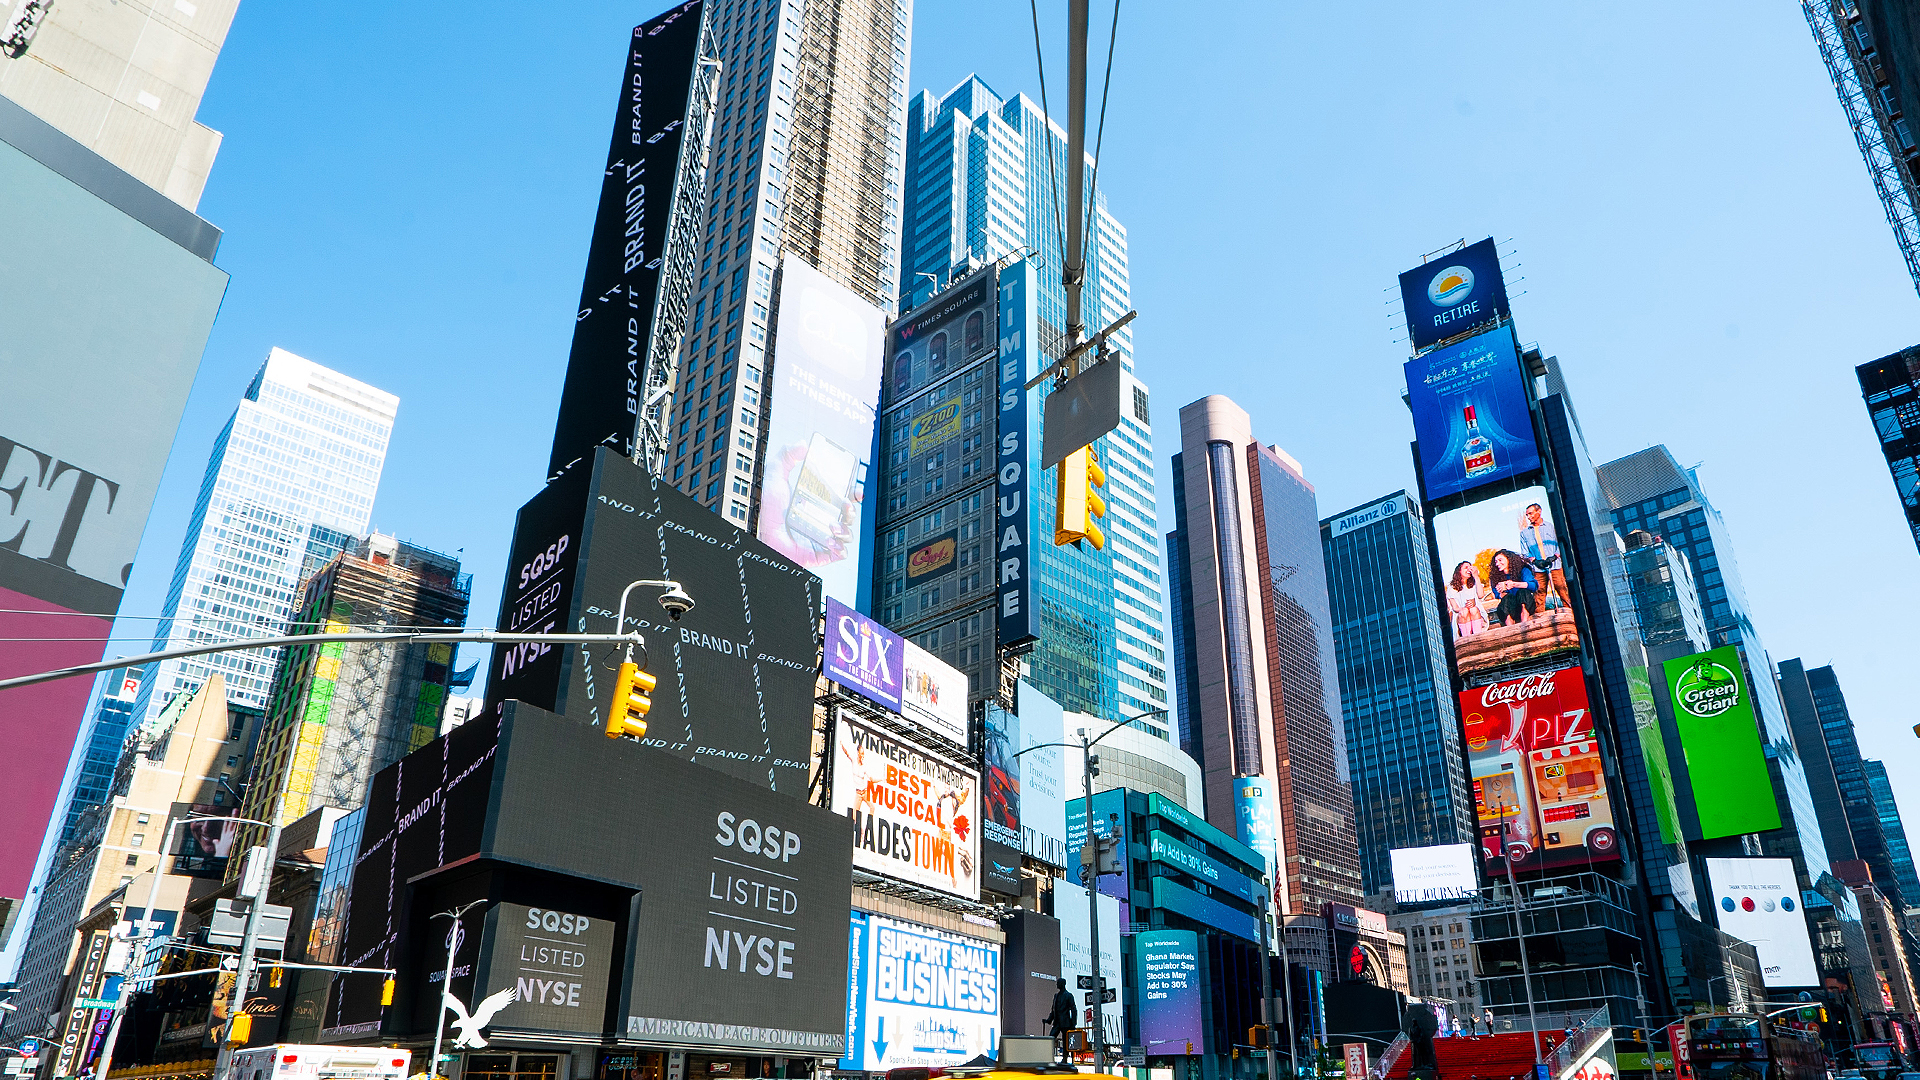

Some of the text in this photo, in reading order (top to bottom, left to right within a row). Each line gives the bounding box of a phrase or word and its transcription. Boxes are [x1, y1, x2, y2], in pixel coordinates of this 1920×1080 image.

[632, 50, 642, 145] BRAND IT
[624, 157, 645, 274] BRAND IT
[901, 289, 979, 339] W TIMES SQUARE
[1434, 300, 1480, 327] RETIRE
[627, 285, 639, 415] BRAND IT
[788, 377, 867, 425] FITNESS APP
[790, 362, 867, 413] THE MENTAL
[917, 403, 957, 439] Z100
[1000, 279, 1021, 618] TIMES SQUARE
[638, 511, 656, 520] IT
[1340, 509, 1379, 531] Allianz
[663, 521, 735, 551] BRAND IT
[518, 534, 569, 590] SQSP
[743, 550, 804, 577] BRAND IT
[737, 555, 751, 624] BRAND
[510, 581, 561, 631] LISTED
[654, 624, 671, 633] IT
[679, 627, 749, 659] BRAND IT
[502, 621, 556, 681] NYSE
[757, 653, 818, 674] BRAND IT
[836, 615, 895, 686] SIX
[123, 679, 136, 694] R
[673, 641, 693, 741] BRAND IT
[848, 663, 859, 677] THE
[860, 668, 883, 690] MUSICAL
[1481, 671, 1556, 707] Coca-Cola
[752, 662, 771, 754] BRAND IT
[1684, 684, 1735, 703] Green
[1693, 695, 1738, 714] Giant
[590, 706, 599, 726] IT
[670, 742, 687, 751] IT
[694, 746, 766, 763] BRAND IT
[848, 723, 911, 768] WINNER!
[919, 758, 937, 779] TONY
[937, 765, 964, 790] AWARDS
[446, 744, 498, 792] BRAND IT
[886, 764, 931, 799] BEST
[1028, 761, 1043, 779] Trust
[1029, 776, 1056, 799] decisions.
[398, 797, 431, 834] BRAND
[432, 787, 442, 807] IT
[866, 781, 946, 829] MUSICAL
[1158, 800, 1189, 825] Top Worldwide
[714, 811, 801, 863] SQSP
[847, 807, 955, 878] HADESTOWN
[984, 818, 1021, 840] EMERGENCY
[984, 828, 1021, 851] RESPONSE
[1151, 839, 1219, 880] May Add to 30% Gains
[709, 872, 799, 915] LISTED
[1422, 885, 1463, 902] JOURNAL
[526, 907, 590, 936] SQSP
[520, 944, 586, 969] LISTED
[704, 927, 796, 980] NYSE
[880, 928, 996, 975] SUPPORT SMALL
[1065, 937, 1081, 953] Trust
[1145, 952, 1195, 962] Ghana Markets
[1062, 954, 1078, 970] Trust
[1146, 961, 1195, 971] Regulator Says
[1146, 971, 1187, 980] Stocks May
[515, 976, 582, 1008] NYSE
[878, 954, 996, 1013] BUSINESS
[1146, 980, 1188, 990] Add to 30%
[1147, 991, 1168, 1000] Gains
[60, 938, 104, 1067] SCIENOLOGY
[83, 999, 116, 1009] Broadway
[244, 996, 282, 1014] Tina
[630, 1016, 845, 1048] AMERICAN EAGLE OUTFITTERS
[889, 1055, 906, 1065] Sports
[907, 1056, 917, 1065] Fan
[917, 1057, 930, 1067] Shop
[933, 1058, 943, 1066] NYC
